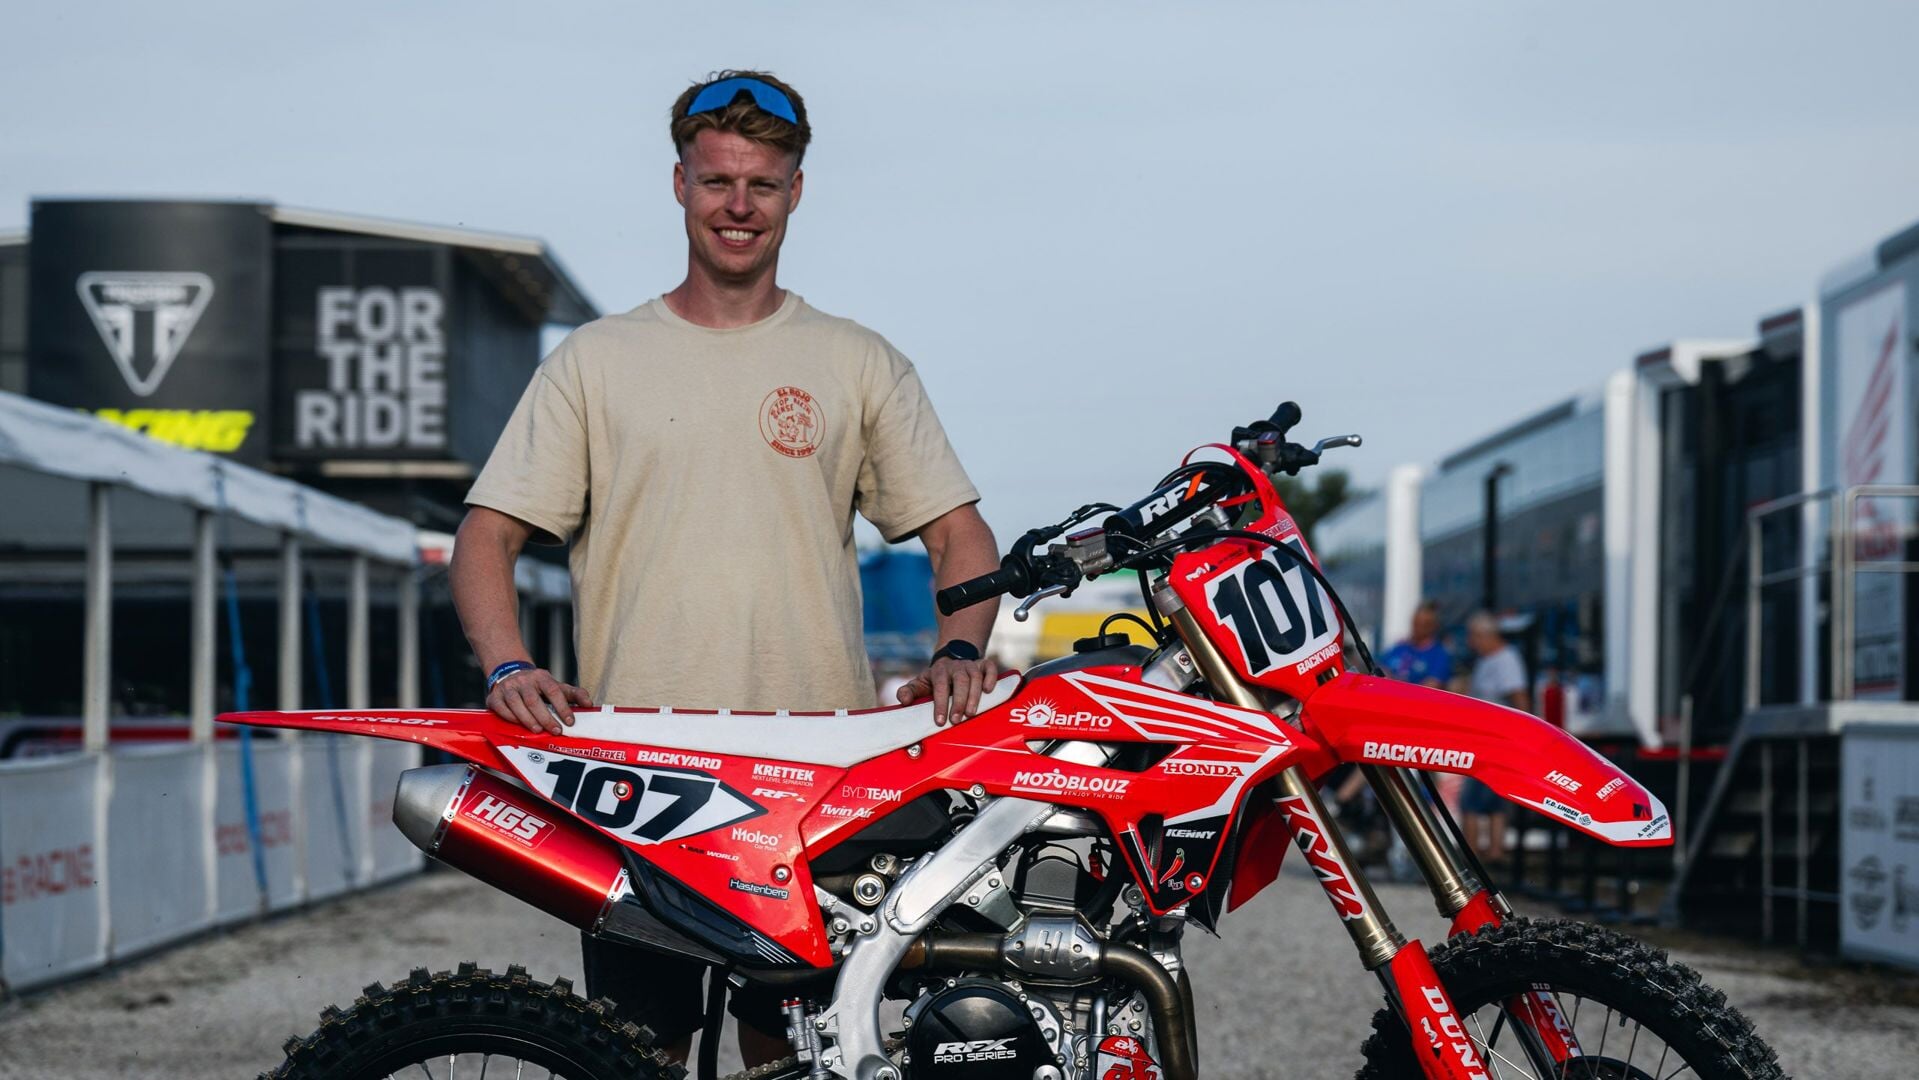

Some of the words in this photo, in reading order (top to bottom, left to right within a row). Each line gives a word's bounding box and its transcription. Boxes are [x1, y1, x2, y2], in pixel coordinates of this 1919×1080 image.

[317, 287, 445, 342] FOR
[324, 344, 445, 392] THE
[96, 408, 255, 453] CING
[297, 393, 446, 448] RIDE
[771, 440, 796, 456] SINCE
[1139, 471, 1210, 527] RFX
[1212, 538, 1328, 676] 107
[1297, 642, 1341, 675] BACKYARD
[592, 747, 626, 760] BERKEL
[637, 750, 722, 770] BACKYARD
[1363, 741, 1475, 769] BACKYARD
[753, 763, 815, 782] KRETTEK
[1013, 768, 1130, 794] MOTOBLOUZ
[1163, 762, 1244, 777] HONDA
[1543, 770, 1582, 793] HGS
[545, 758, 716, 842] 107
[821, 804, 853, 816] Twin
[854, 807, 875, 819] Air
[472, 795, 547, 840] HGS
[1165, 828, 1216, 839] KENNY
[706, 850, 739, 861] WORLD
[933, 1038, 1018, 1054] RFX
[934, 1053, 963, 1064] PRO
[967, 1050, 1016, 1062] SERIES
